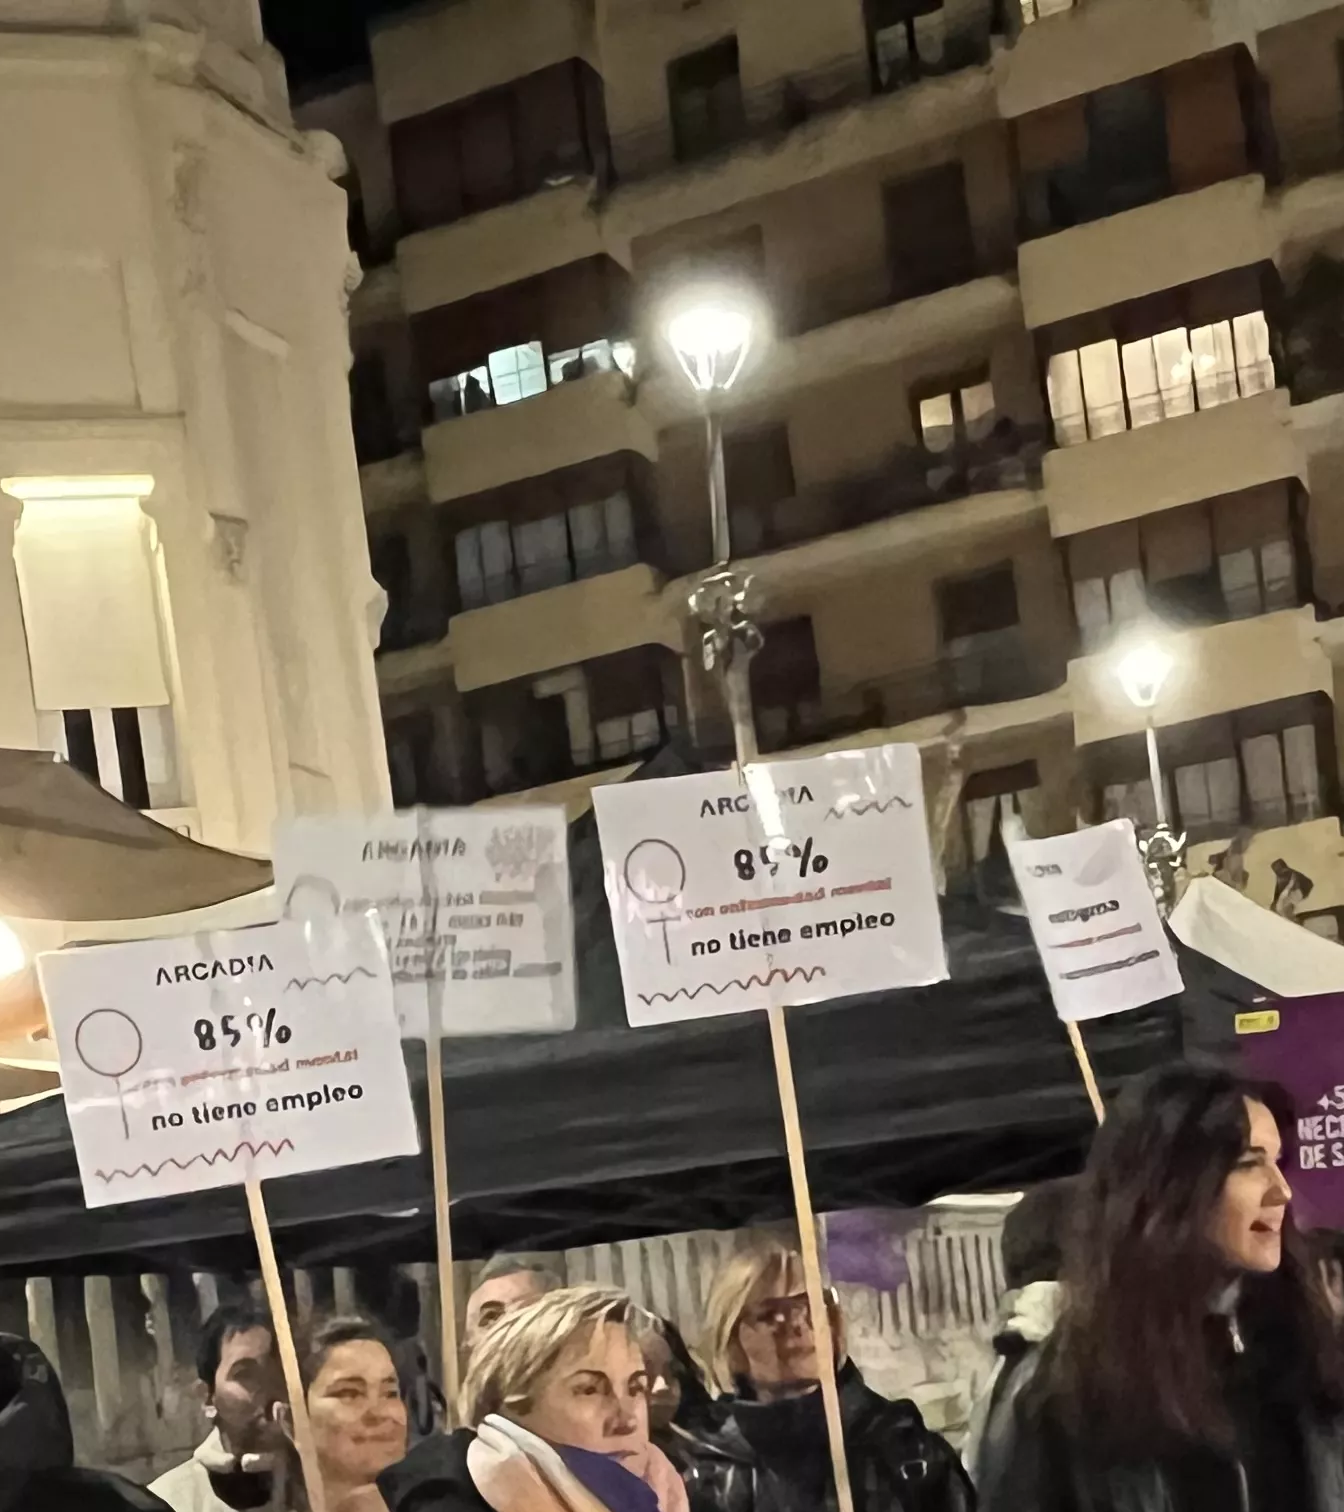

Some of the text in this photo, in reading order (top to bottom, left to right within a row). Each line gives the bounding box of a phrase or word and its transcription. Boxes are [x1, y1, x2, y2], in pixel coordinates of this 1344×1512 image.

[700, 785, 814, 818] ARCIA
[691, 911, 896, 957] no tiene empleo
[156, 953, 274, 986] ARCADIA
[193, 1007, 292, 1051] 85%
[151, 1083, 365, 1131] no tiene empleo
[1299, 1144, 1327, 1170] DE
